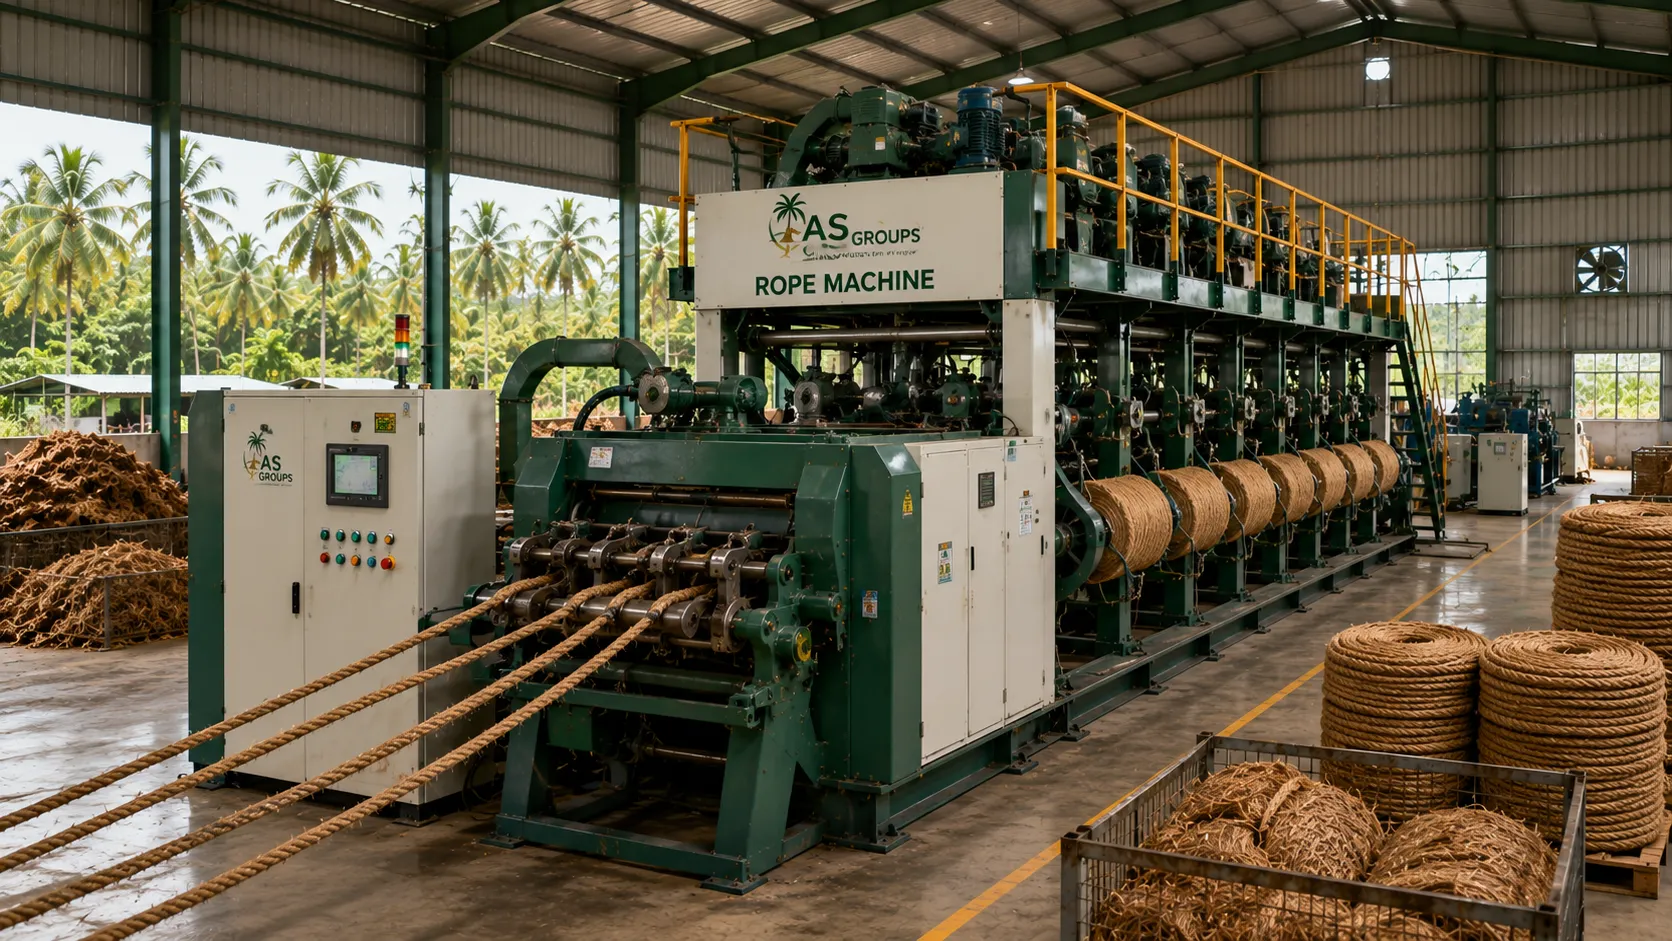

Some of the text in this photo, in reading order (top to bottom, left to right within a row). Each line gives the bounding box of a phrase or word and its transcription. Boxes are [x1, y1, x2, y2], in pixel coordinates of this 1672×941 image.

[802, 213, 921, 246] AS GROUPS
[755, 269, 935, 296] ROPE MACHINE
[260, 454, 281, 472] AS
[258, 472, 293, 483] GROUPS
